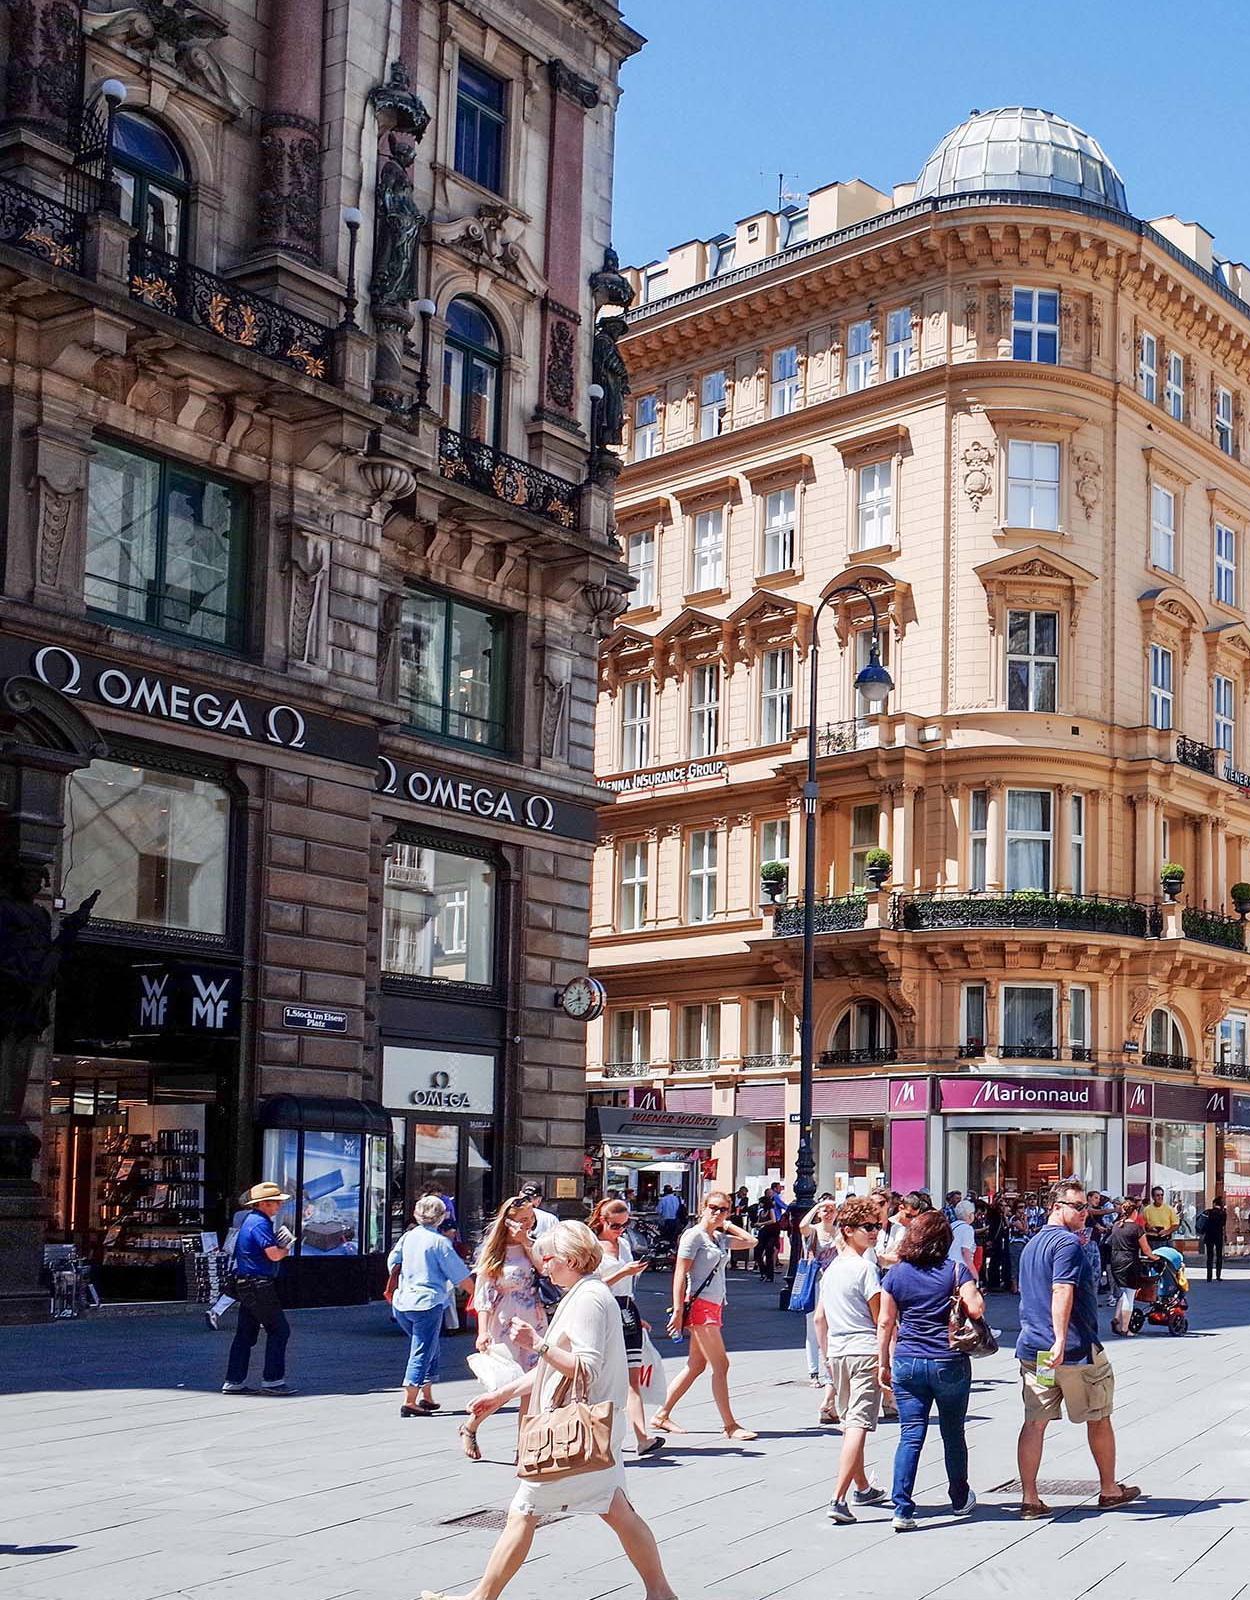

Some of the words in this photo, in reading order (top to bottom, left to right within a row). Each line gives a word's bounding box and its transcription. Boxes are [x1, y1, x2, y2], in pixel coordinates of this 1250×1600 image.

[99, 669, 252, 735] OMEGA
[632, 767, 686, 787] INSURANCE
[688, 761, 724, 778] GROUP
[1223, 766, 1249, 787] WIENER
[408, 772, 516, 821] OMEGA
[413, 1090, 471, 1108] OMEGA
[973, 1080, 1089, 1107] Marionnaud
